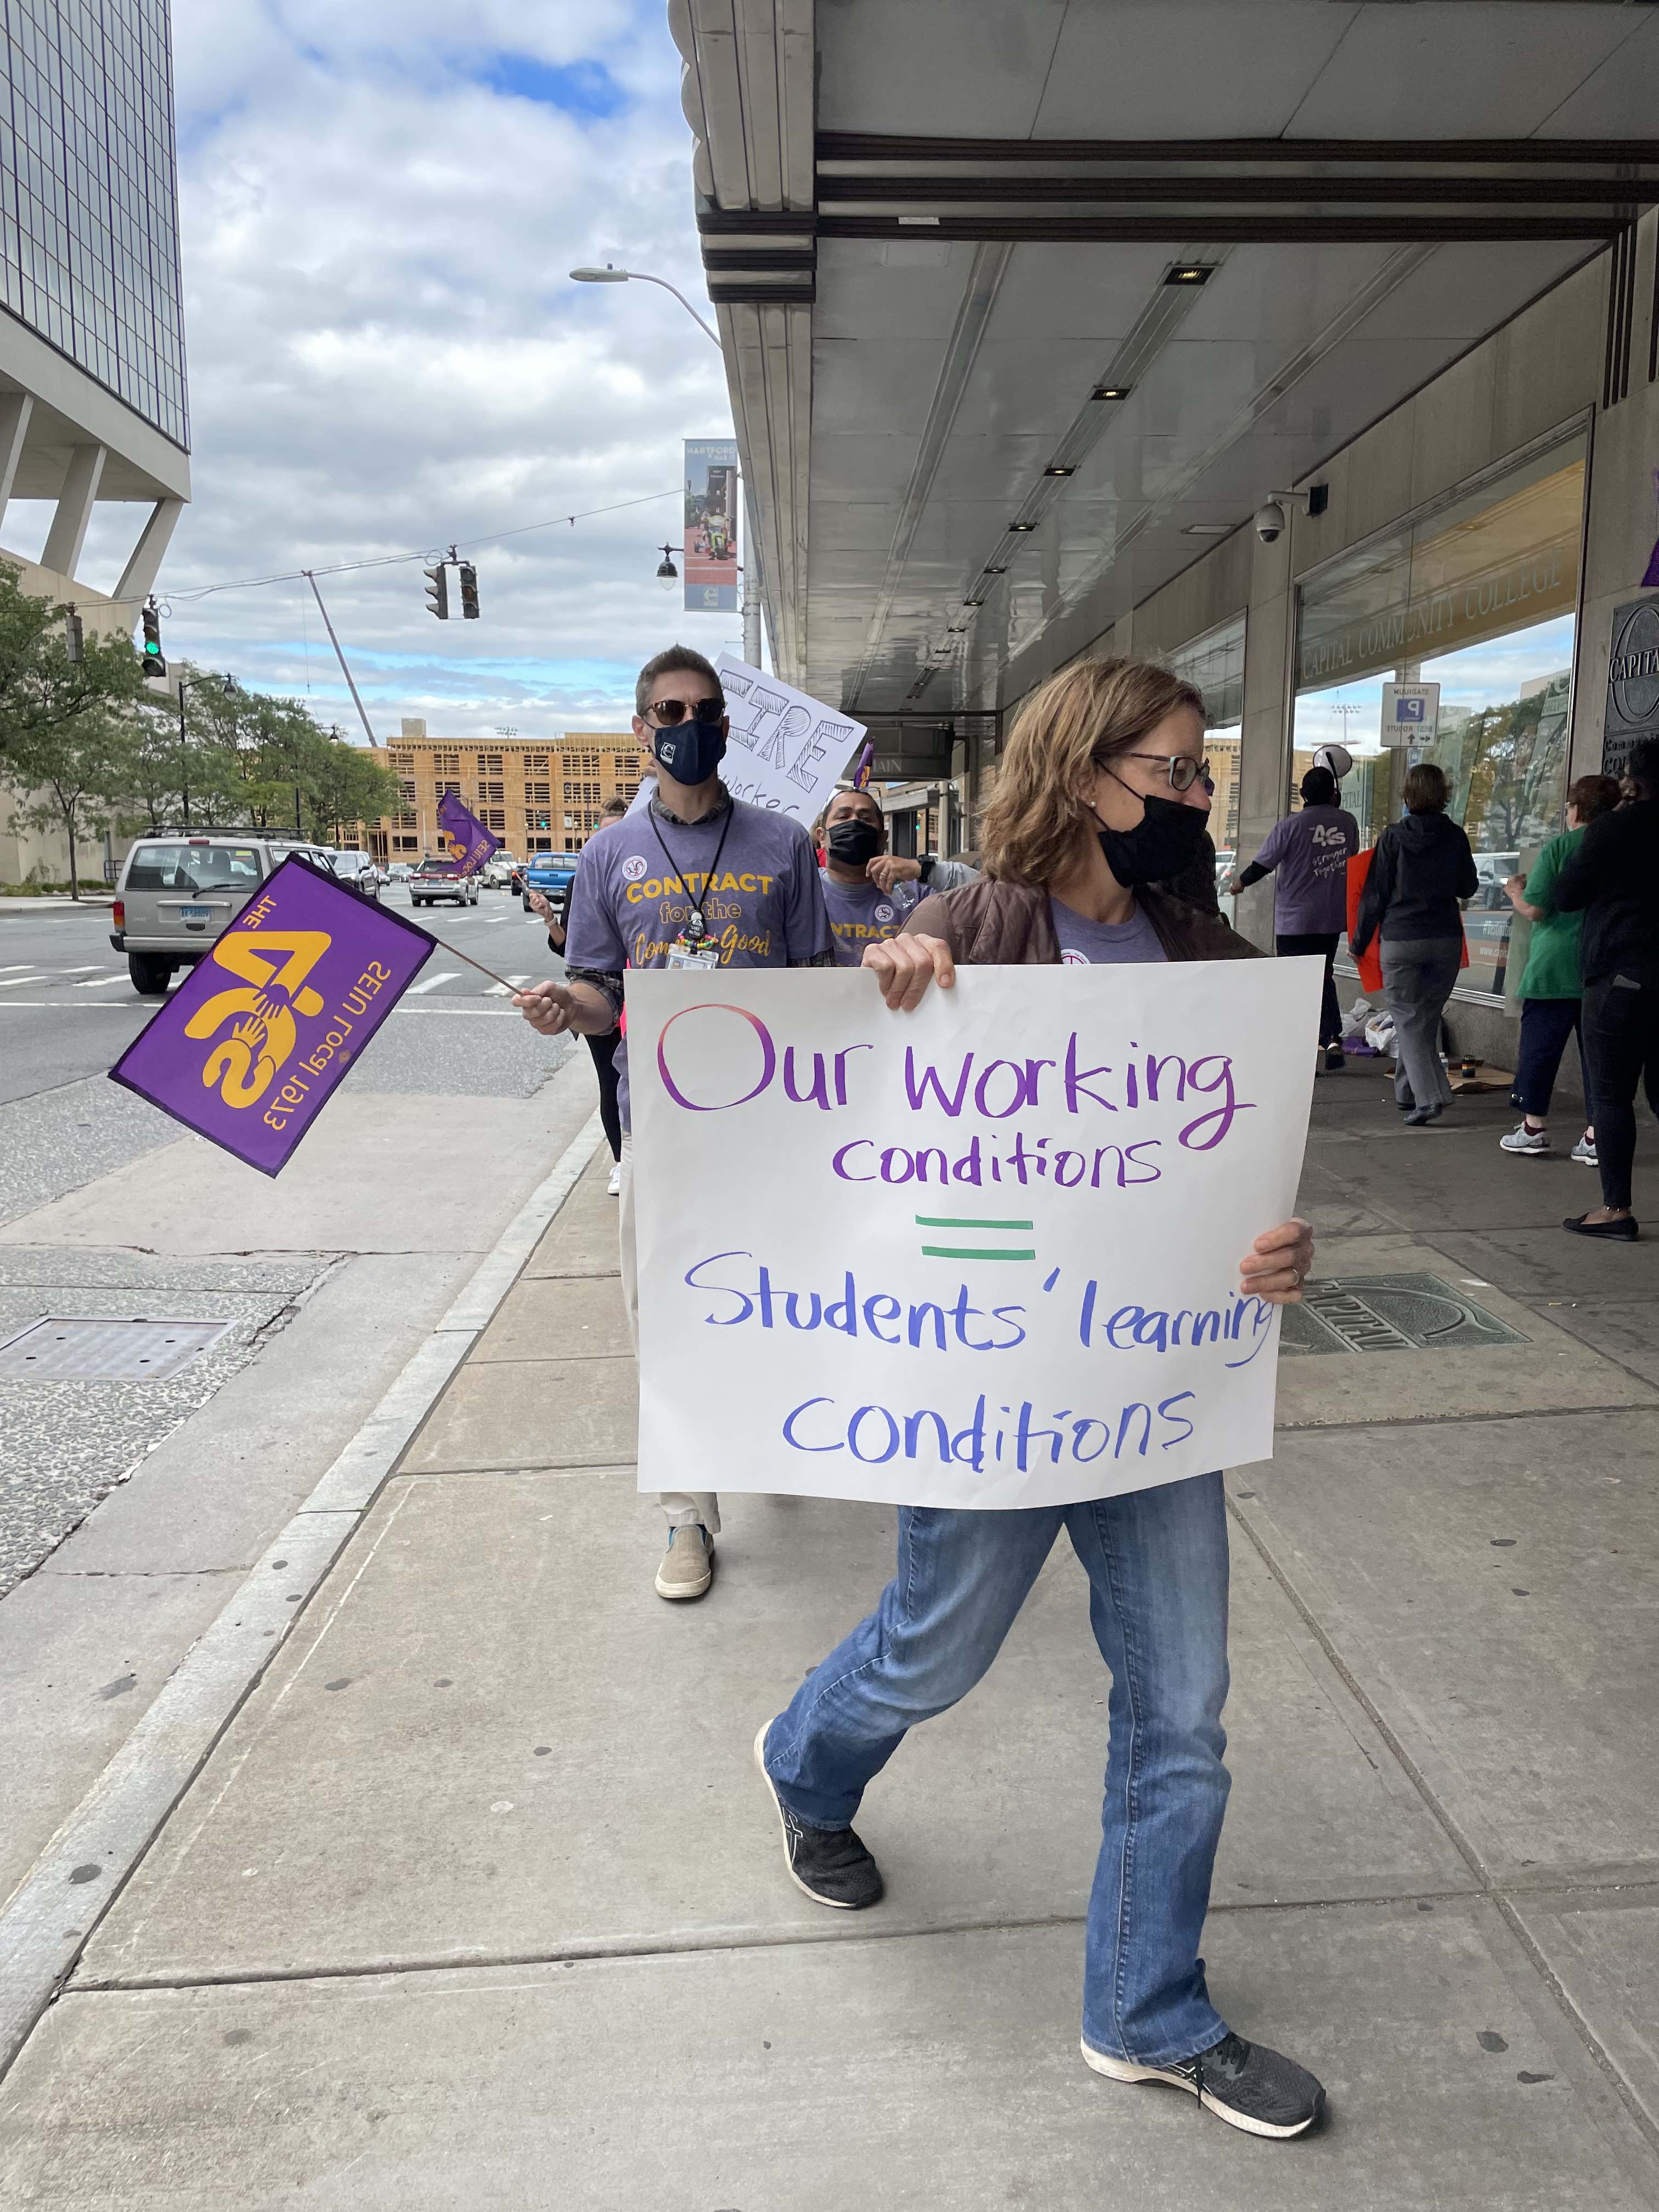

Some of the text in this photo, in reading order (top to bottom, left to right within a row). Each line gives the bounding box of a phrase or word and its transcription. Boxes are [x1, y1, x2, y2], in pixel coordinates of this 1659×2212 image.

[686, 447, 736, 455] HARTFORD
[1302, 635, 1353, 680] CAPITAL
[1465, 547, 1562, 620] COLLEGE
[627, 872, 773, 904] CONTRACT
[702, 898, 742, 921] the
[720, 924, 771, 964] Good
[658, 1003, 873, 1111] Our
[832, 1131, 1163, 1188] conditions
[684, 1251, 1274, 1368] Students' learning
